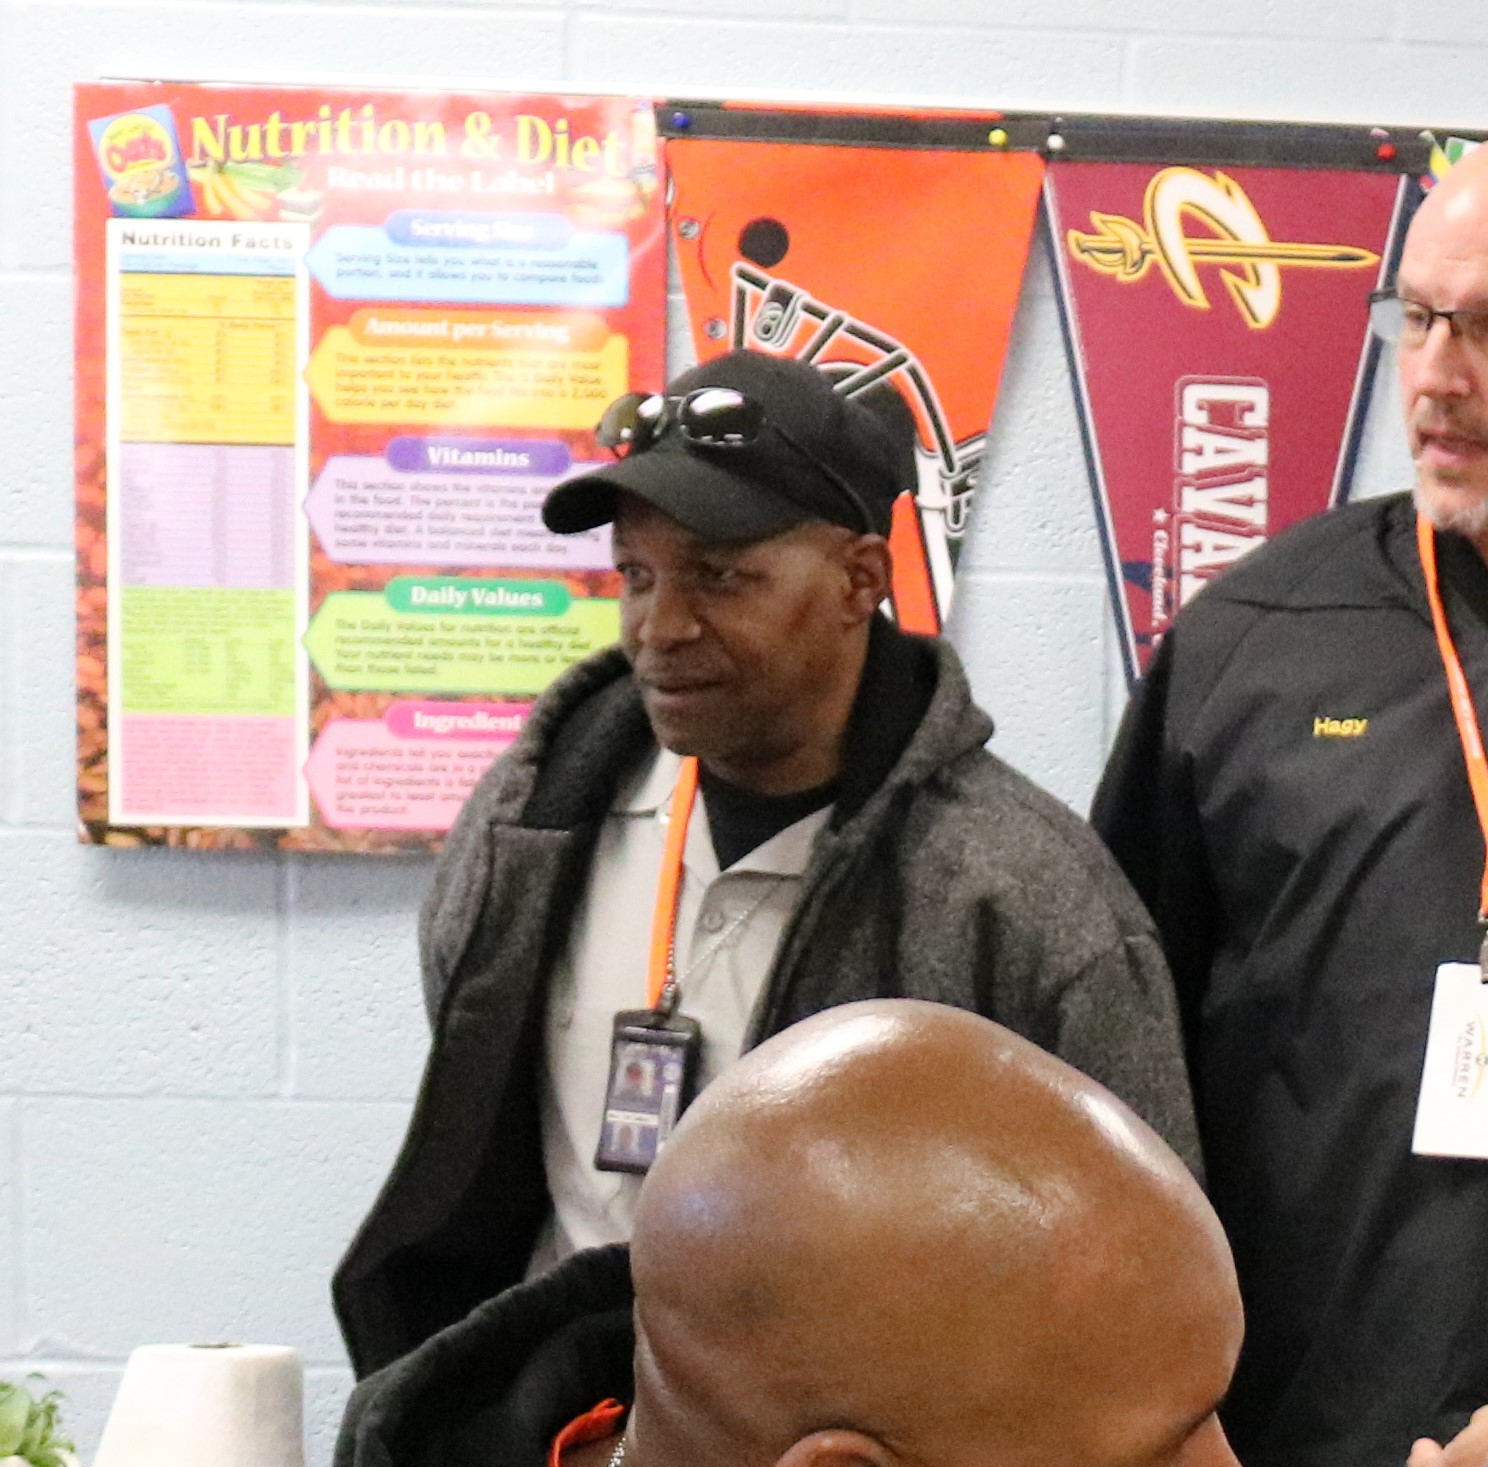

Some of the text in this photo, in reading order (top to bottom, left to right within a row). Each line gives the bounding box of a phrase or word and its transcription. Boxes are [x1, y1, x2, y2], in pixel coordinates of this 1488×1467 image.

[191, 104, 627, 173] Nutrition & Diet
[327, 166, 554, 194] Read the Label
[121, 229, 293, 250] Nutrition Facts
[365, 317, 570, 343] Amount per Serving
[427, 446, 529, 467] Vitamins
[1179, 382, 1271, 608] CAVA
[410, 585, 544, 607] Daily Values
[413, 712, 523, 733] Ingredient
[1313, 716, 1368, 738] Hagy
[1456, 1020, 1477, 1099] WARREN
